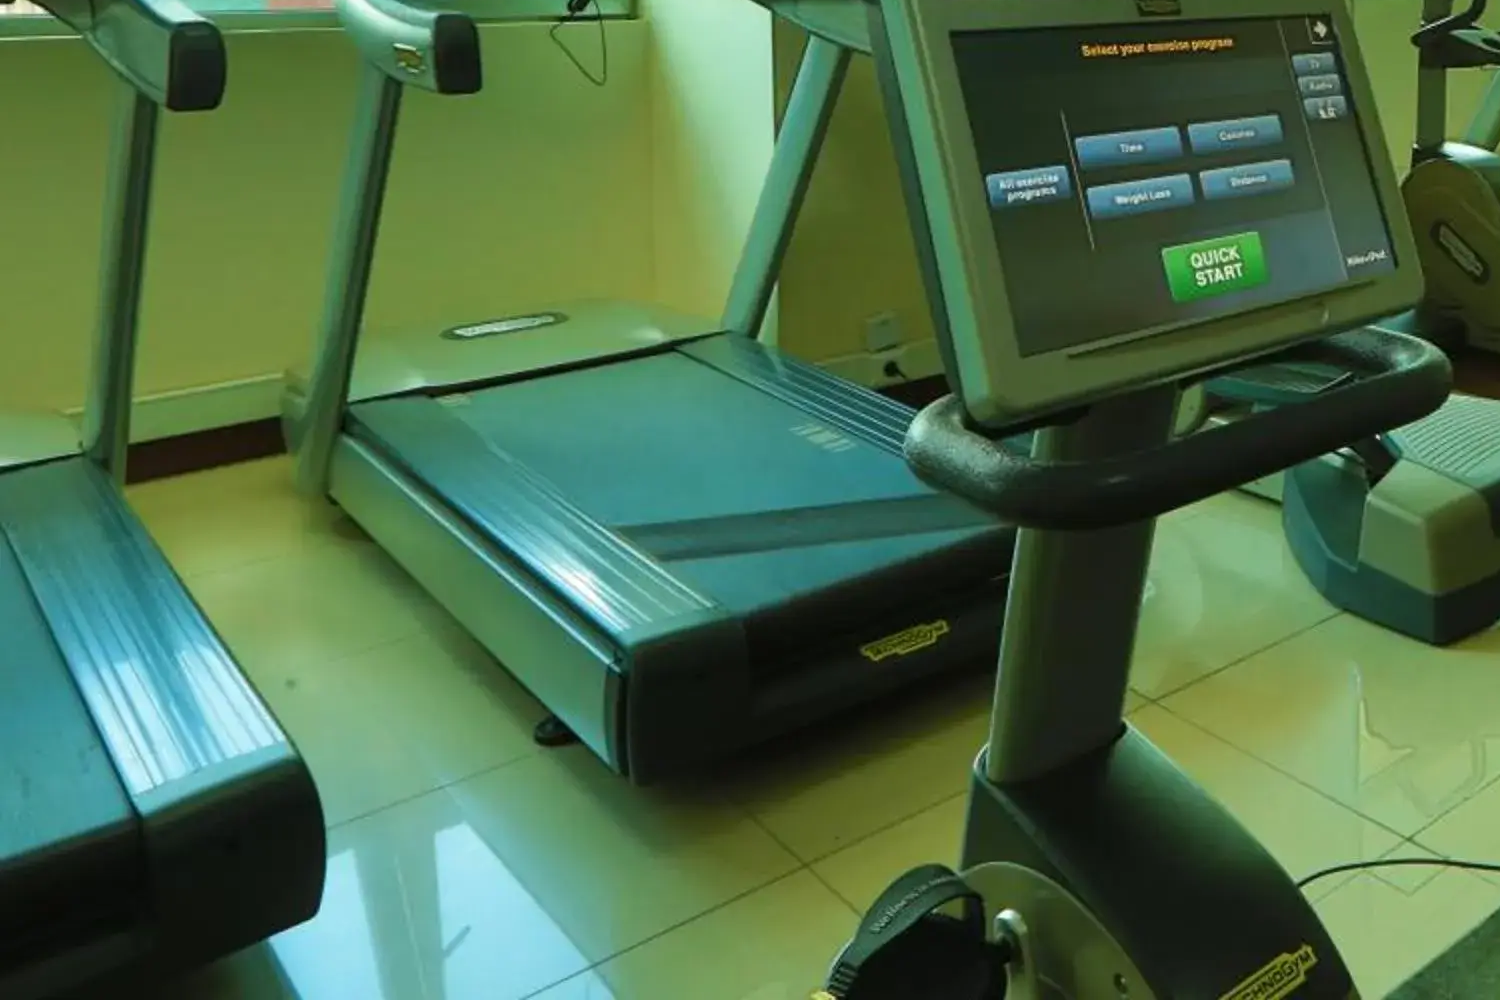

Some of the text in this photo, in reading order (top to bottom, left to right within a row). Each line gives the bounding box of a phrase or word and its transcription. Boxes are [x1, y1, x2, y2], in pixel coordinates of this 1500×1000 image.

[1119, 142, 1144, 153] Time
[1006, 184, 1057, 203] programs
[1113, 191, 1148, 206] Weight
[1189, 244, 1242, 270] QUICK
[1194, 261, 1245, 288] START
[1222, 946, 1316, 1000] CHNOGYM
